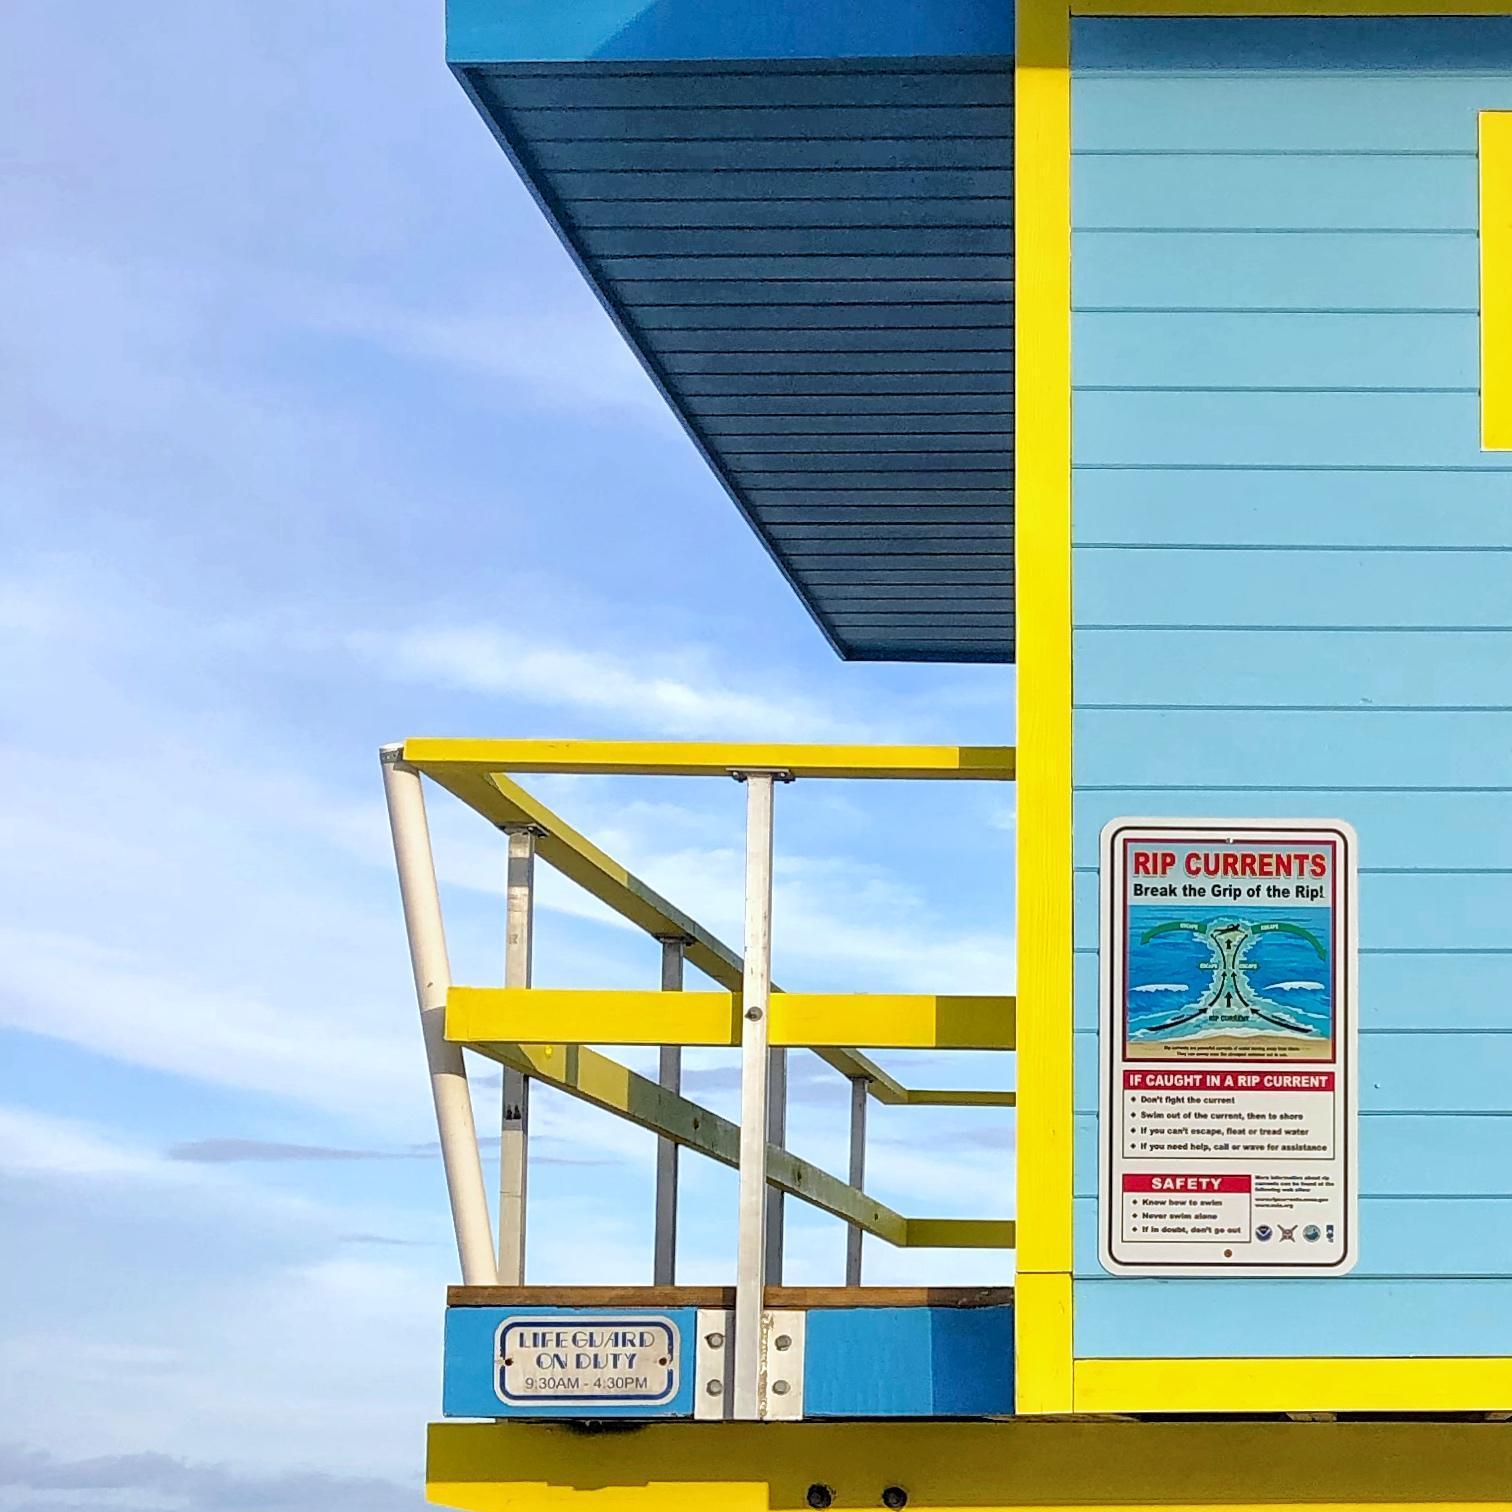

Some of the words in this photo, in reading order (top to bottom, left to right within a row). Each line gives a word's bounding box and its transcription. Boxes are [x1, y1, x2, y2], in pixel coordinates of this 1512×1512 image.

[1132, 851, 1177, 877] RIP
[1184, 851, 1328, 878] CURRENTS
[1133, 883, 1177, 897] Break
[1182, 883, 1206, 898] the
[1211, 883, 1242, 901] Grip
[1246, 884, 1262, 898] of
[1266, 884, 1291, 899] the
[1295, 884, 1324, 902] Rip!
[1129, 1074, 1142, 1087] IF
[1145, 1074, 1202, 1087] CAUGHT
[1206, 1074, 1221, 1087] IN
[1224, 1074, 1234, 1087] A
[1237, 1075, 1260, 1087] RIP
[1263, 1075, 1328, 1088] CURRENT
[1151, 1177, 1223, 1190] SAFETY
[519, 1331, 655, 1349] LIFEGUARD
[535, 1352, 568, 1370] ON
[575, 1352, 637, 1370] DUTY
[525, 1377, 580, 1389] 9:30AM
[593, 1377, 648, 1389] 4:30PM
